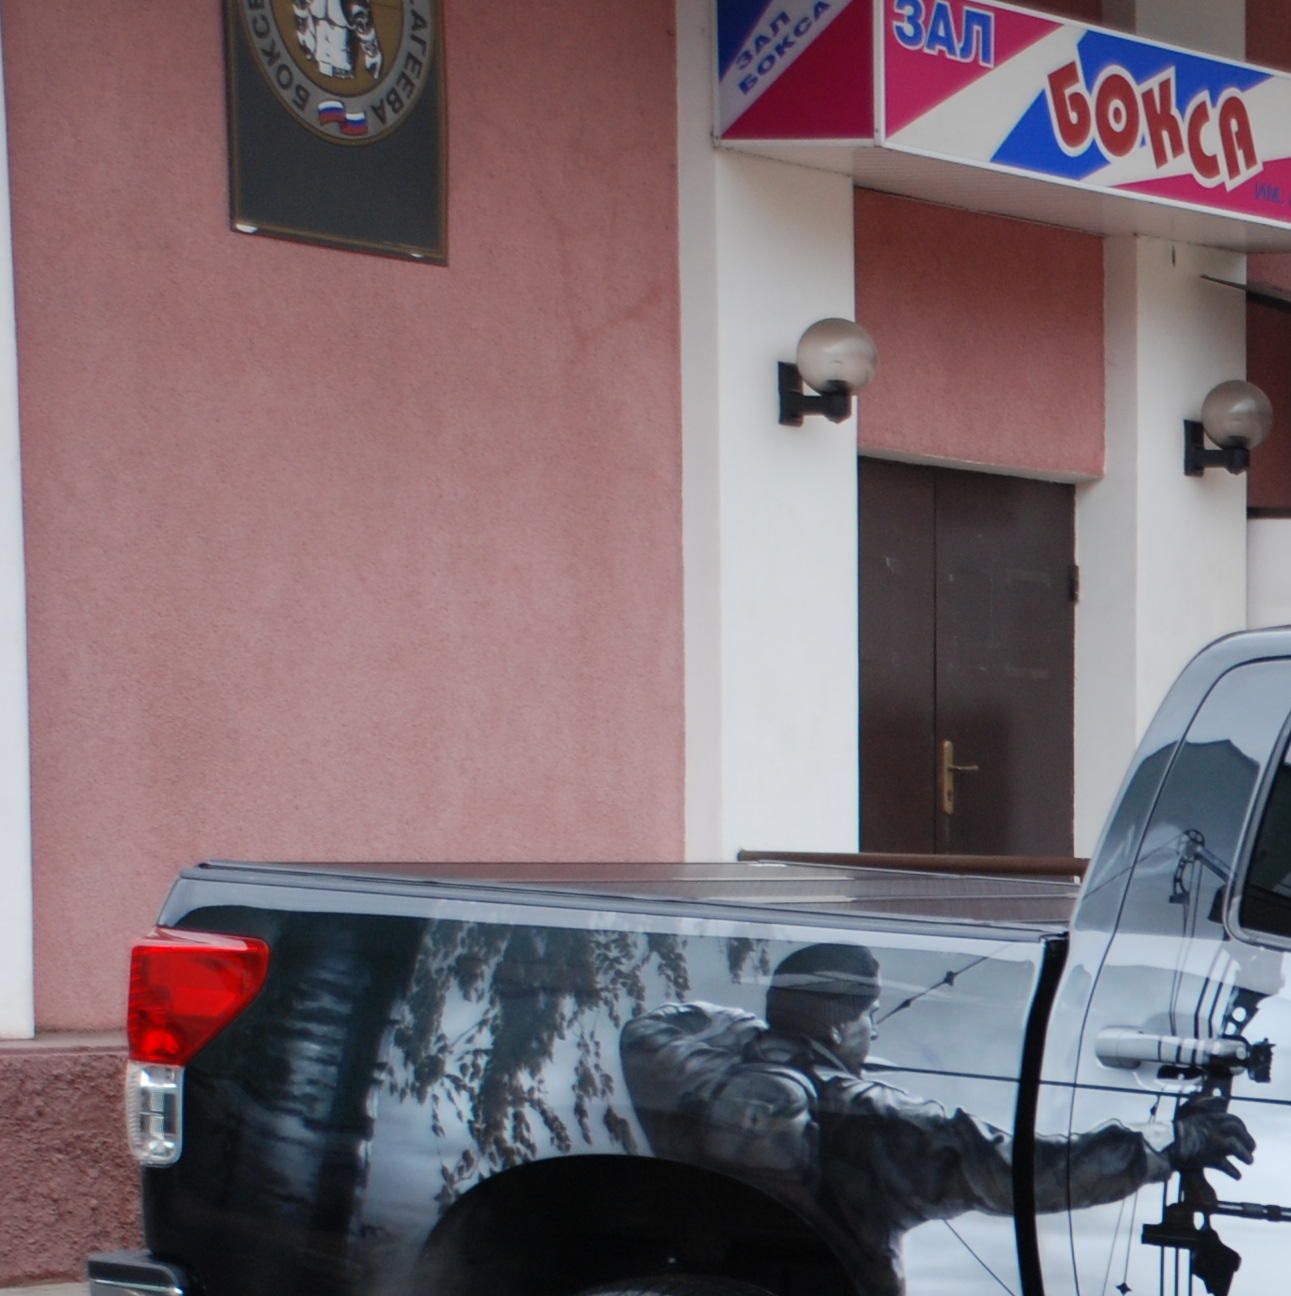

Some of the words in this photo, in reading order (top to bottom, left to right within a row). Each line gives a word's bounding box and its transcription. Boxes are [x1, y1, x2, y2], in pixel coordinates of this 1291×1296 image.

[735, 11, 791, 70] ЗАЛ
[738, 1, 831, 95] БОКСА
[893, 0, 995, 68] ЗАЛ
[1045, 61, 1263, 190] БОКСА
